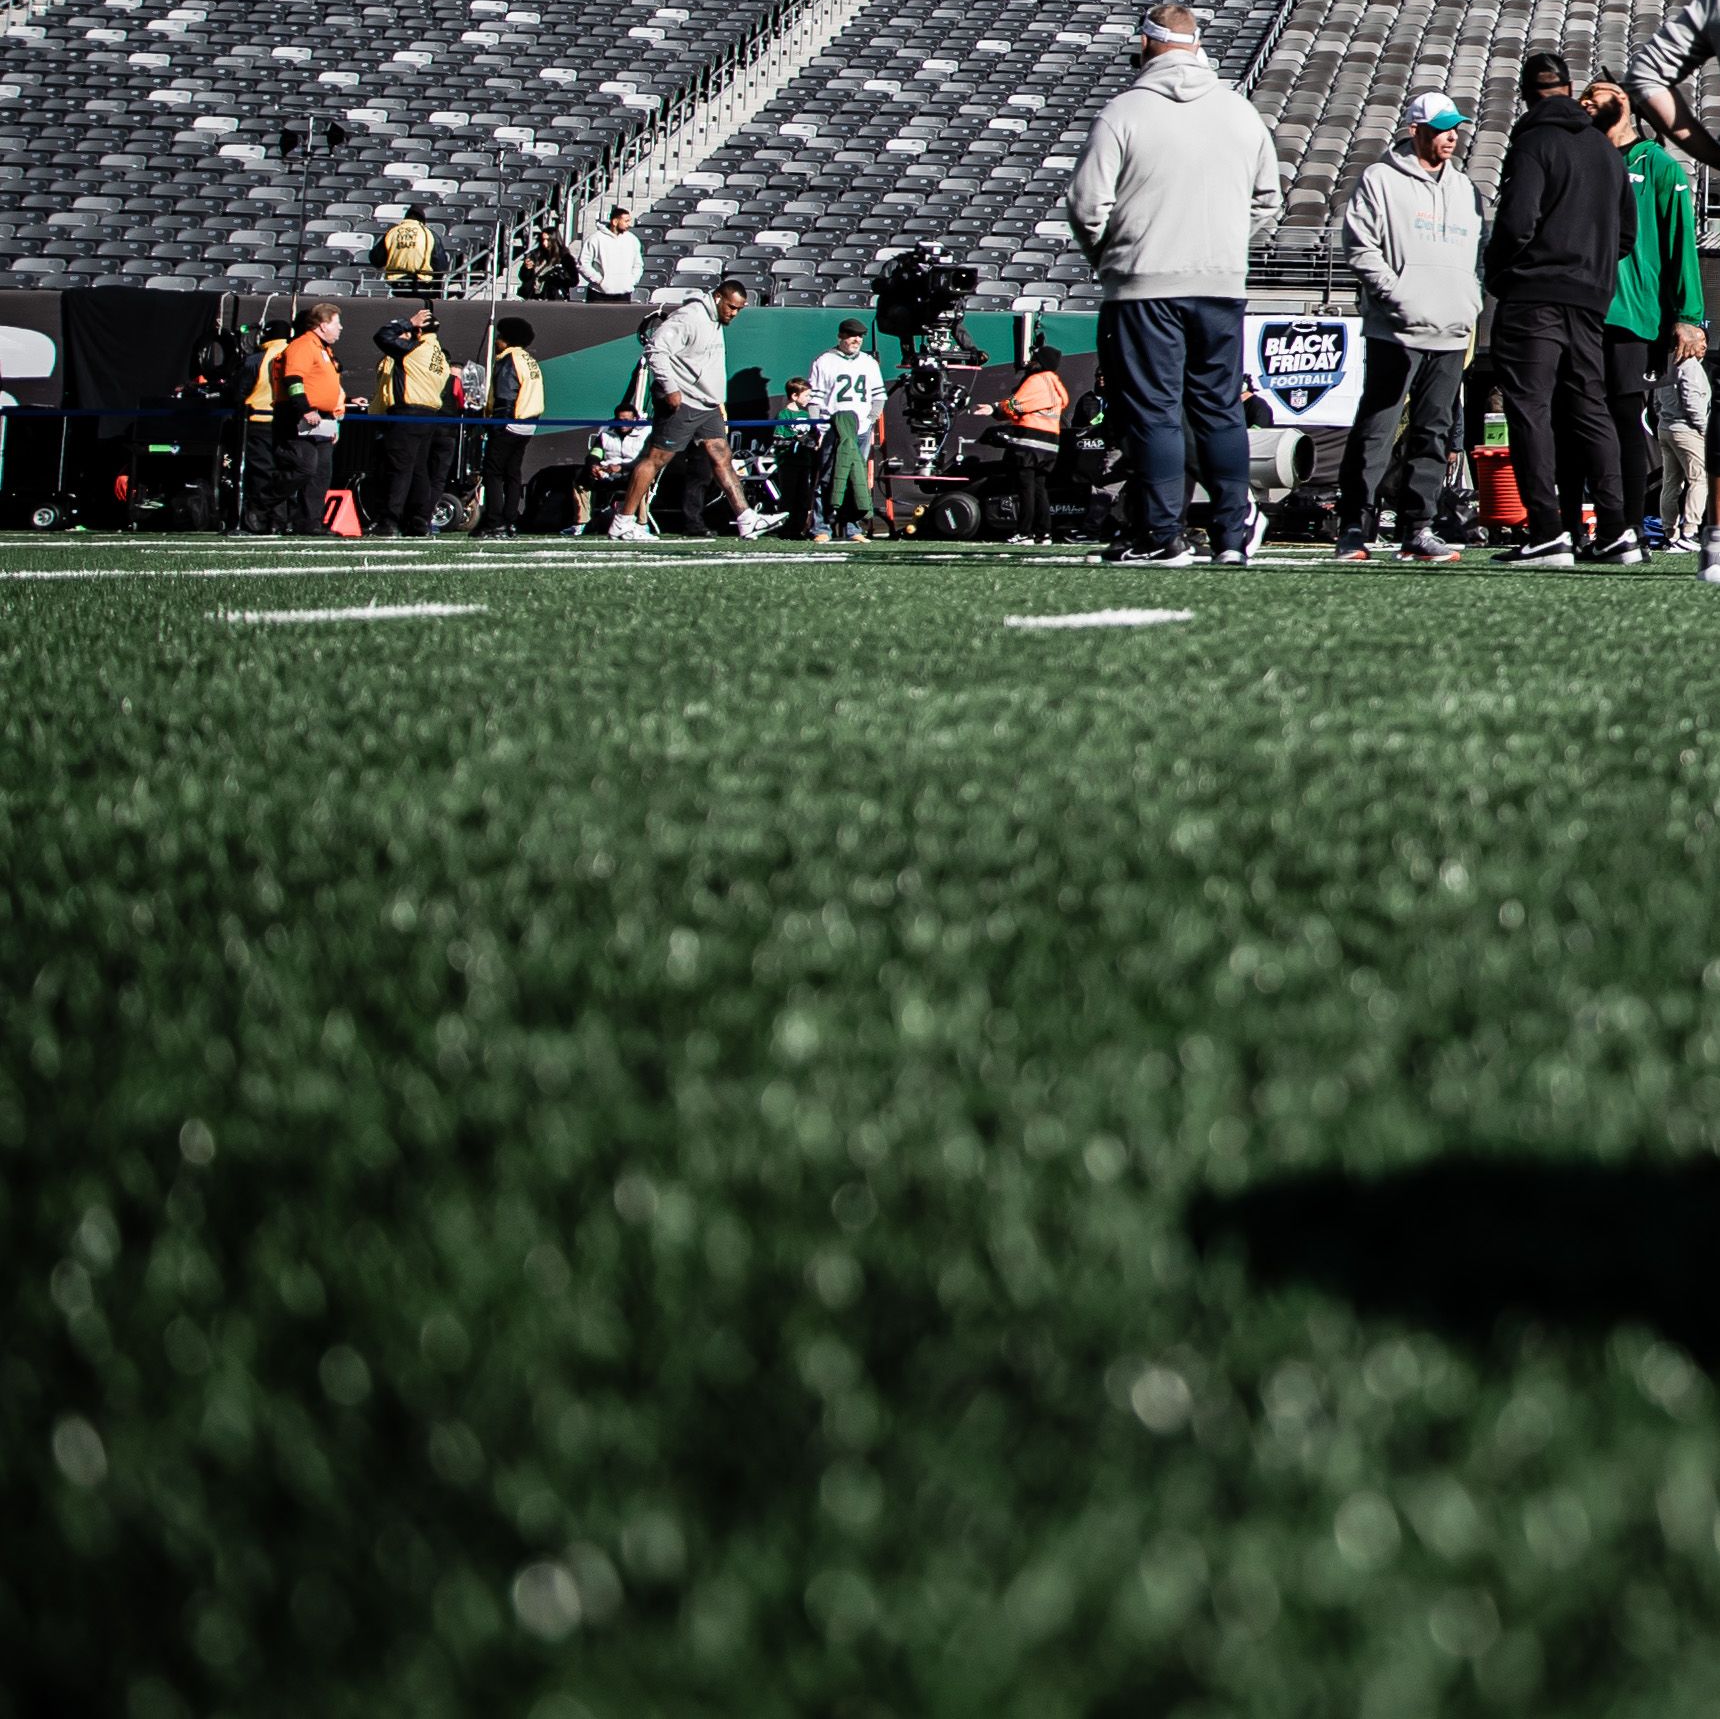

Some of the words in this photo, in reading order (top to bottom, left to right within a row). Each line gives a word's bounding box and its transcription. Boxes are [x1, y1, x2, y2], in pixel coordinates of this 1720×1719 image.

[1264, 333, 1339, 356] BLACK
[1268, 351, 1343, 374] FRIDAY
[835, 374, 867, 403] 24
[1269, 374, 1335, 388] FOOTBALL
